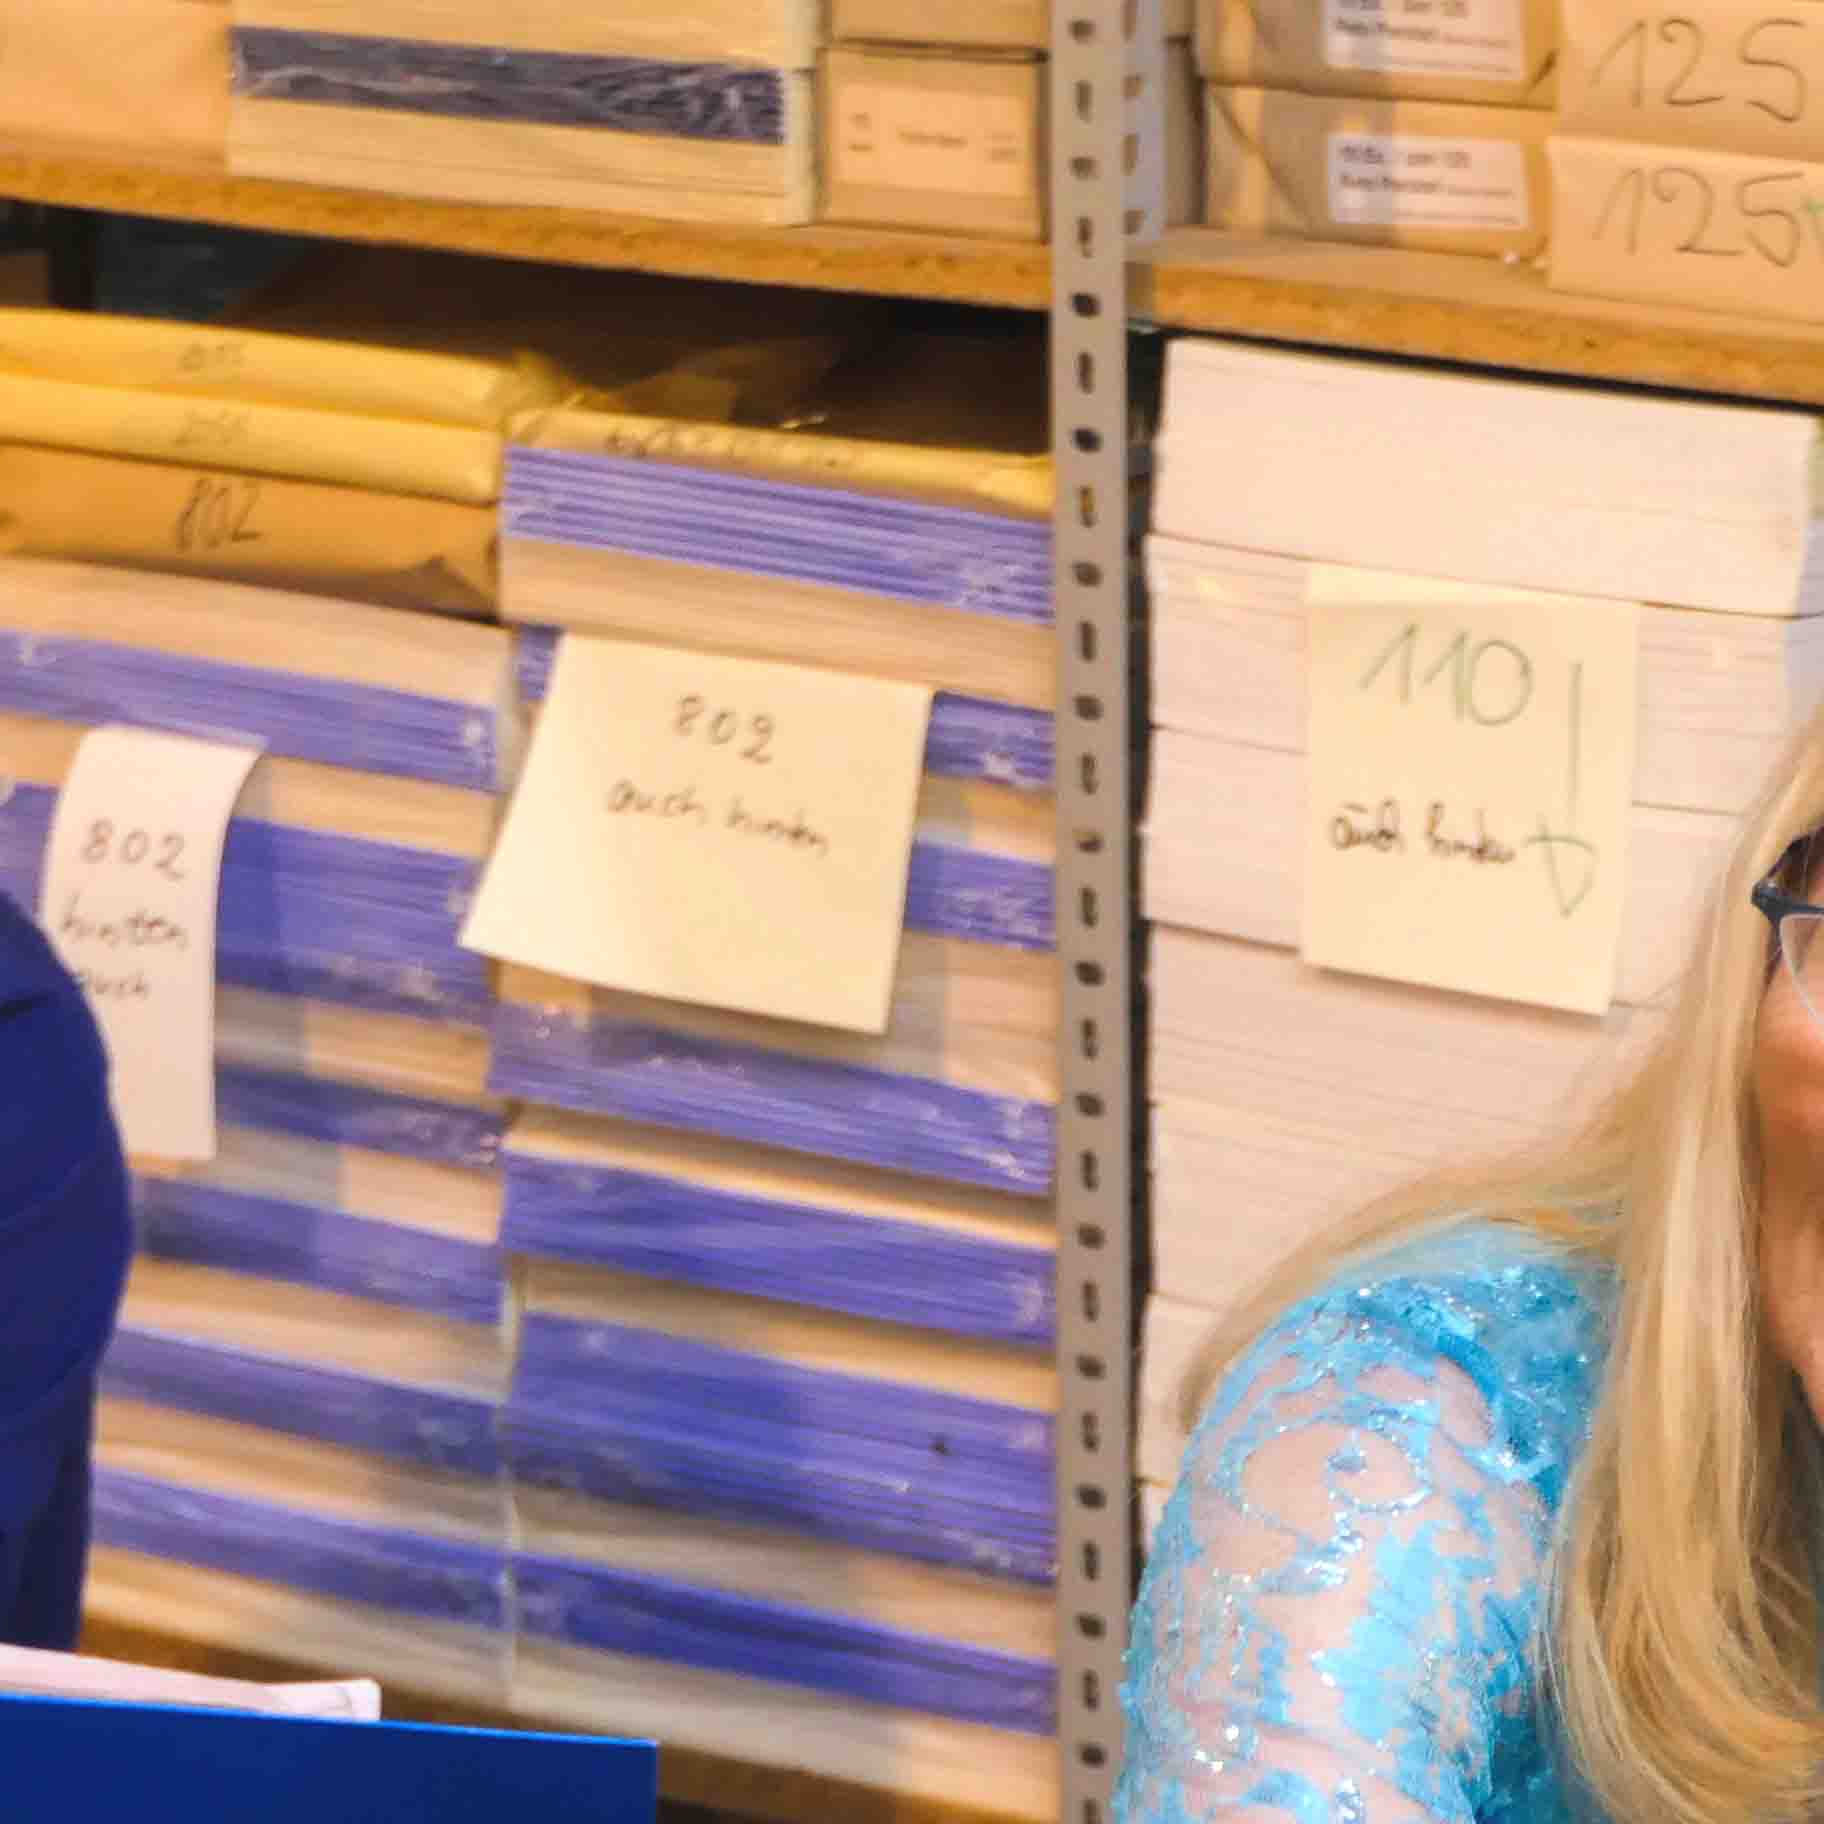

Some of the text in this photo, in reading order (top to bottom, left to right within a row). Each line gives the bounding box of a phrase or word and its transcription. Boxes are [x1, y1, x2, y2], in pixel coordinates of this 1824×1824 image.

[1587, 18, 1808, 124] 125
[1591, 166, 1806, 268] 125
[1358, 623, 1533, 727] 110
[672, 690, 775, 767] 802
[80, 819, 187, 882] 802
